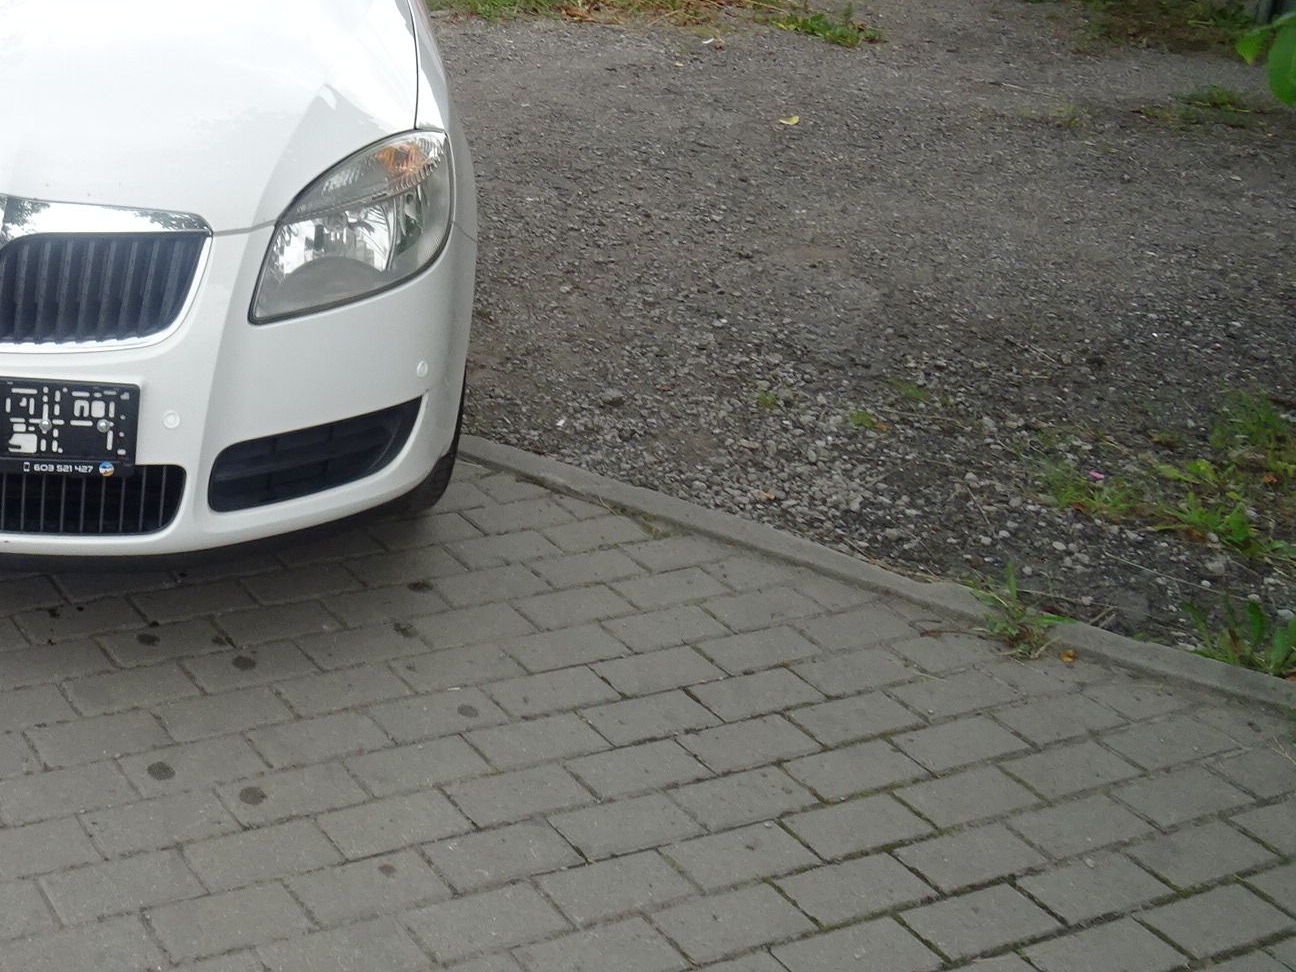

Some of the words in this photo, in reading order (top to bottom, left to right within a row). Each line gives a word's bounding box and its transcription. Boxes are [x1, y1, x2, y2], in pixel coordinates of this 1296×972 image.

[33, 463, 55, 473] 603
[56, 464, 73, 473] 521
[74, 465, 94, 474] 427
